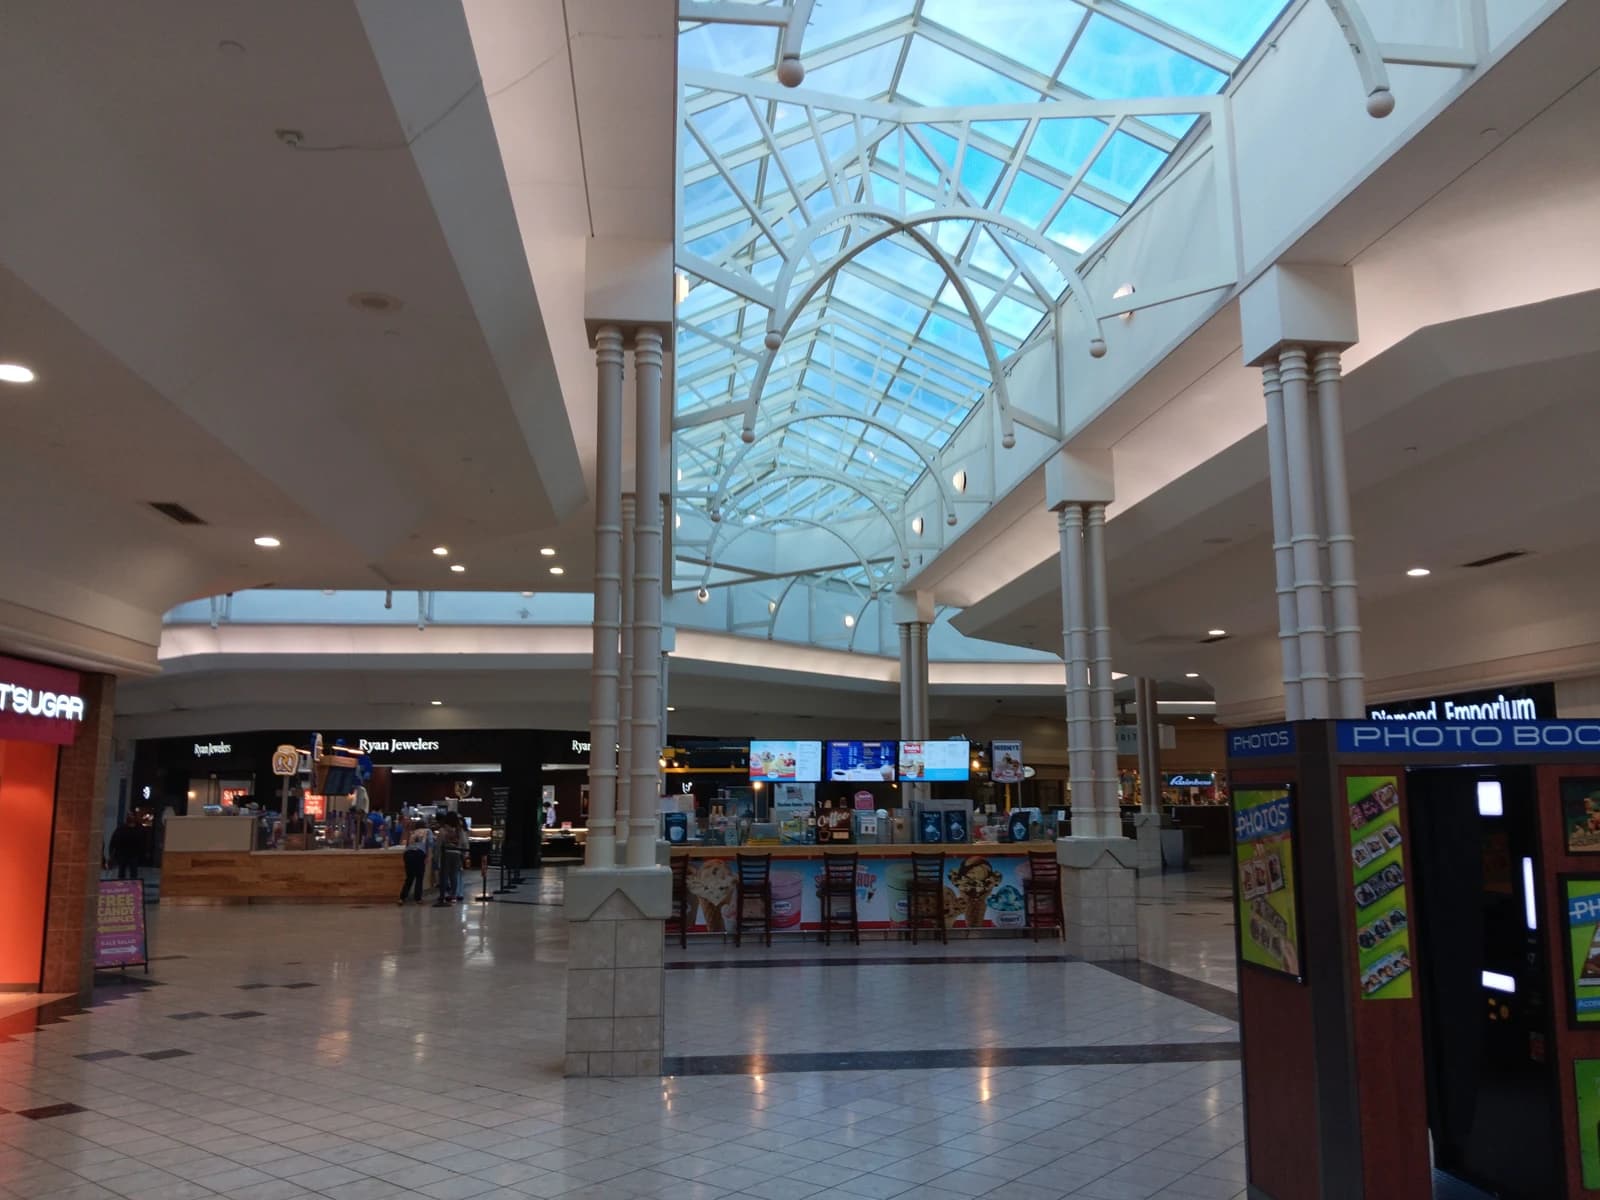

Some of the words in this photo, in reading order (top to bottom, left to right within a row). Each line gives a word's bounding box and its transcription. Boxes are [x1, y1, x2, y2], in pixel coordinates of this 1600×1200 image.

[1233, 731, 1289, 750] PHOTOS
[1353, 726, 1503, 747] PHOTO
[359, 739, 389, 754] Ryan
[390, 738, 439, 753] Jewelers
[1235, 803, 1290, 837] PHOTOS
[97, 894, 135, 907] FREE
[97, 906, 135, 917] CANDY
